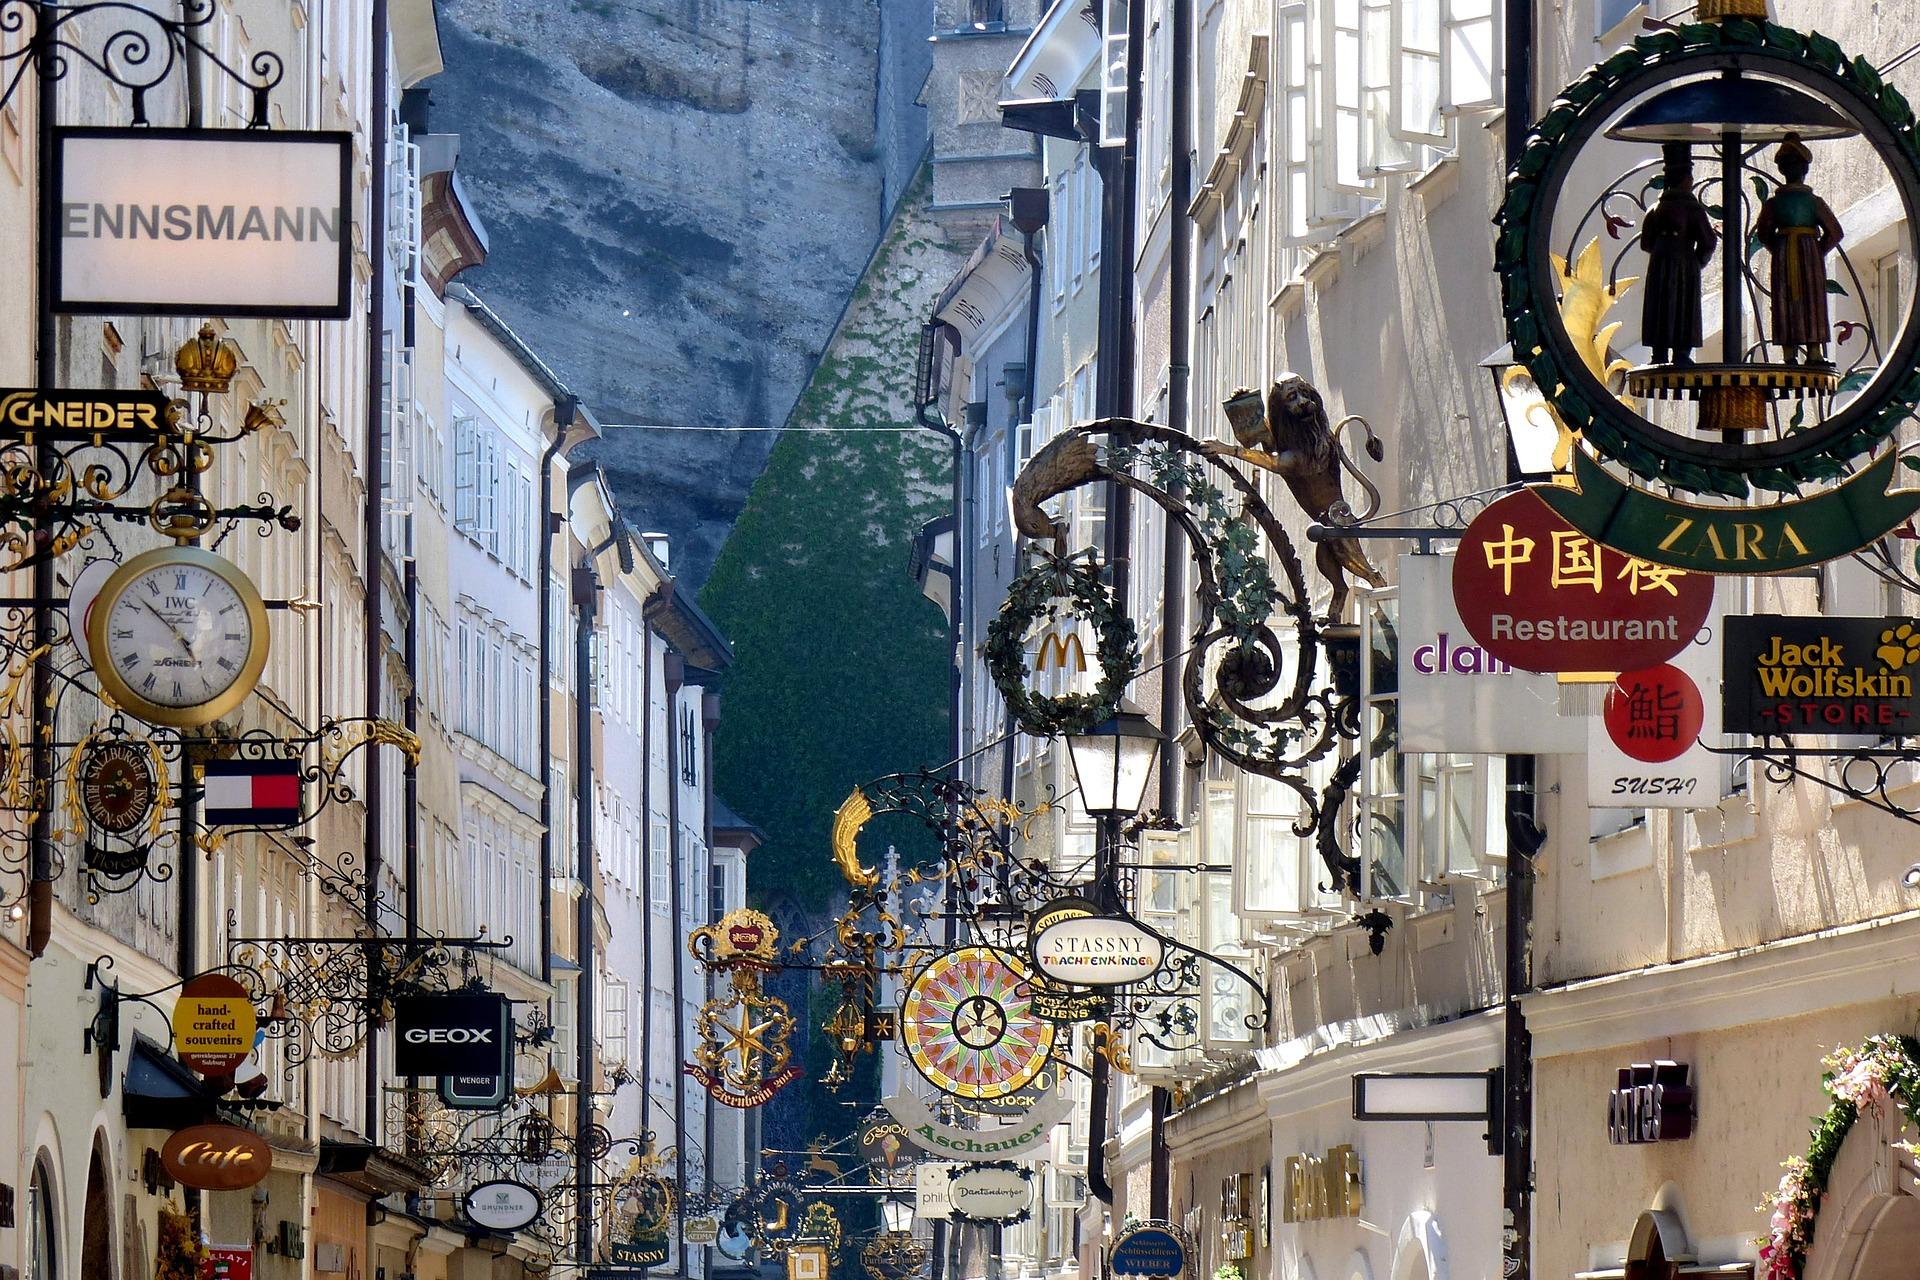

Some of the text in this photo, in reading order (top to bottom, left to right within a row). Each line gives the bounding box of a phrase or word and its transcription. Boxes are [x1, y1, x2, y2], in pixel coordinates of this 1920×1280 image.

[62, 202, 339, 242] ENNSMANN
[1657, 514, 1808, 562] ZARA
[165, 596, 196, 609] IWC
[1491, 614, 1679, 640] Restaurant
[1758, 637, 1845, 667] Jack
[1758, 667, 1913, 697] Wolfskin
[87, 746, 148, 781] SALZBURGER
[1611, 777, 1698, 795] SUSHI
[1054, 937, 1144, 953] STASSNY
[197, 1004, 231, 1015] hand-
[1039, 1006, 1091, 1019] DIENS
[193, 1018, 235, 1030] crafted
[185, 1034, 243, 1045] souvenirs
[405, 1028, 493, 1043] GEOX
[459, 1077, 490, 1085] WENGER
[914, 1122, 1044, 1153] Aschauer
[177, 1142, 255, 1169] Café
[756, 1182, 805, 1204] SALAMANDER
[616, 1249, 664, 1263] STASSNY
